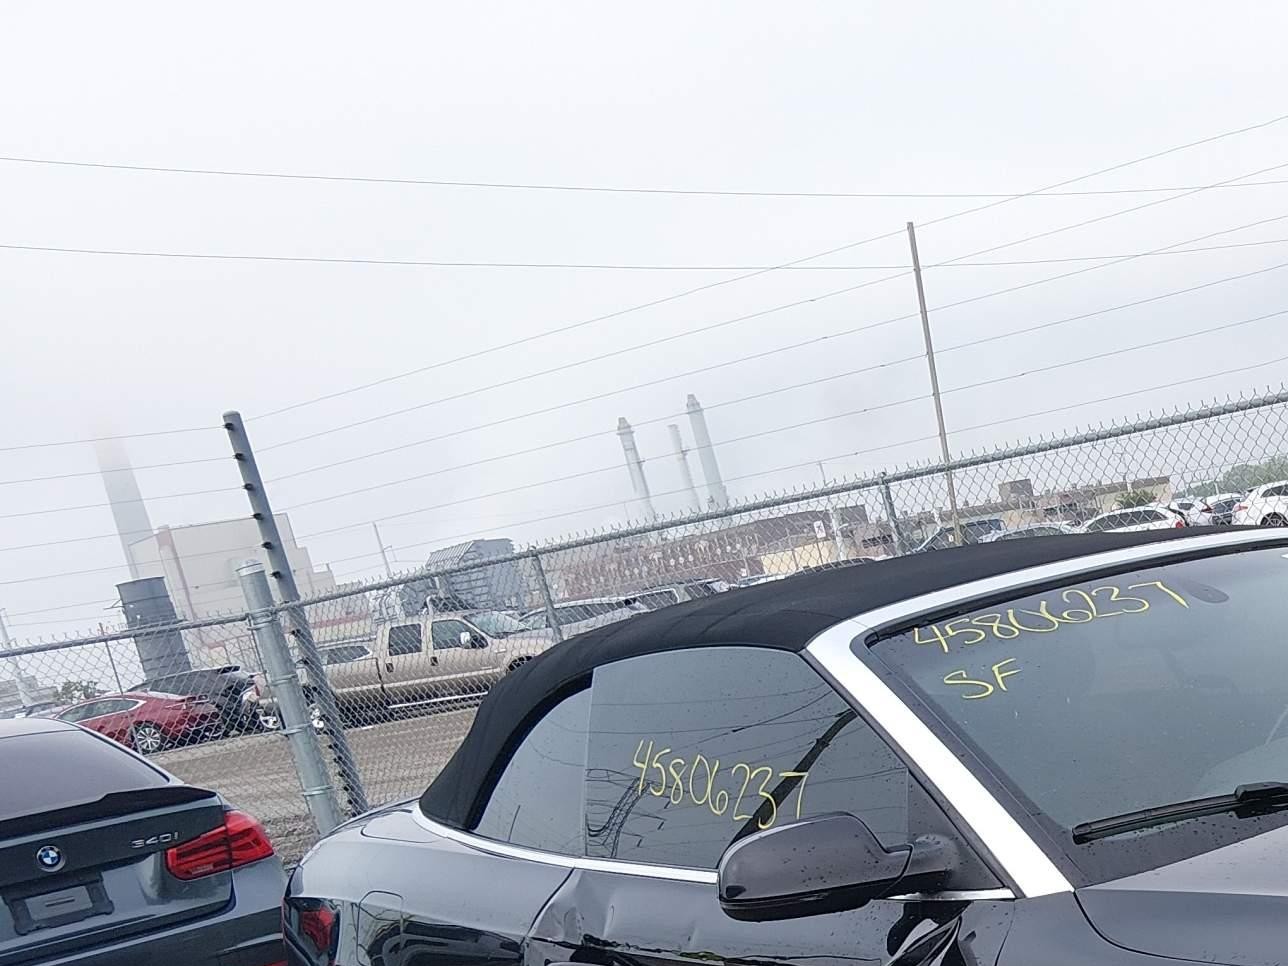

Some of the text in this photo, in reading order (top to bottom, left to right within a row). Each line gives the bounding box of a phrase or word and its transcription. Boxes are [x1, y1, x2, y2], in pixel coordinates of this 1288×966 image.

[914, 582, 1189, 653] 45806237
[943, 657, 1022, 699] SF
[633, 739, 809, 829] 45806237
